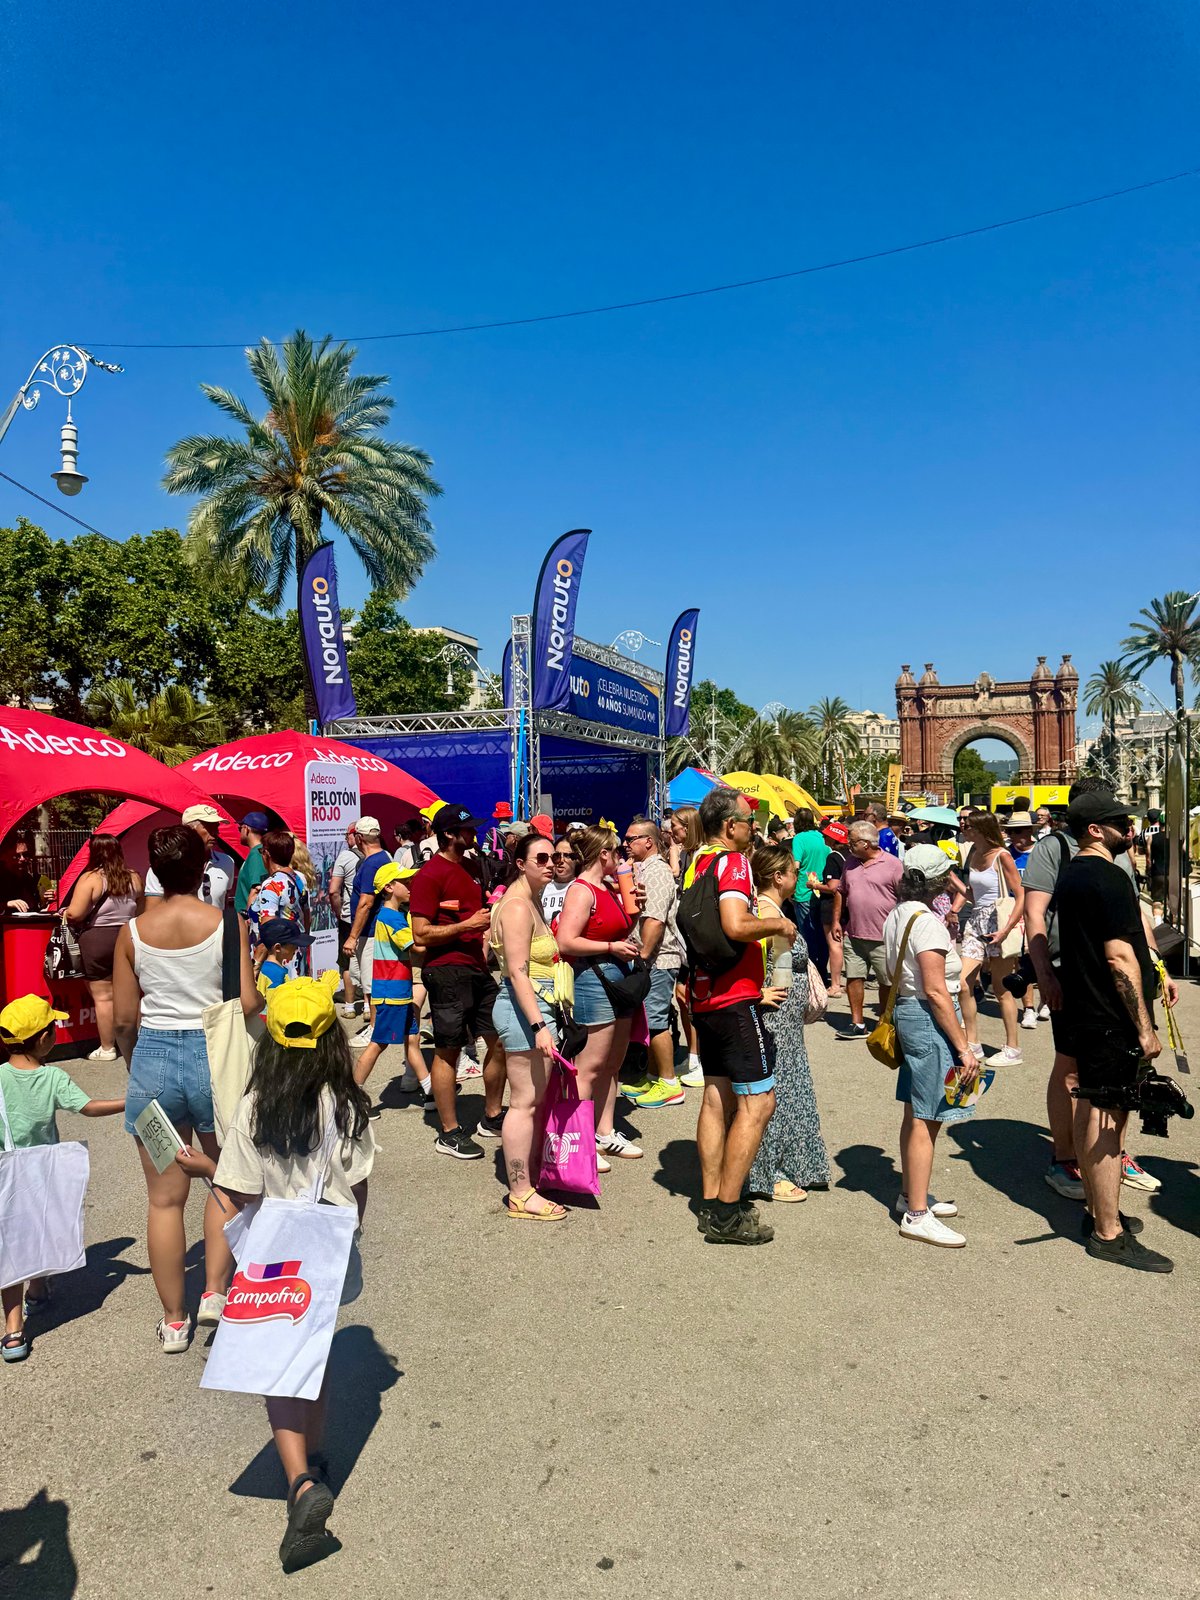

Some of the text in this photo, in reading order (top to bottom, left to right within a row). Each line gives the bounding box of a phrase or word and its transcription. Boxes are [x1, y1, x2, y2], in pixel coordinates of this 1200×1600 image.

[547, 559, 573, 671] Norauto
[312, 577, 344, 684] Norauto
[673, 628, 692, 708] Norauto
[605, 695, 622, 714] AÑOS
[622, 703, 647, 721] SUMANDO
[623, 687, 649, 706] NUESTROS
[0, 726, 126, 757] Adecco
[193, 751, 293, 772] Adecco
[311, 773, 337, 785] Adecco
[311, 787, 357, 806] PELOTÓN
[311, 806, 341, 822] ROJO
[749, 1004, 768, 1074] bicimarket.com
